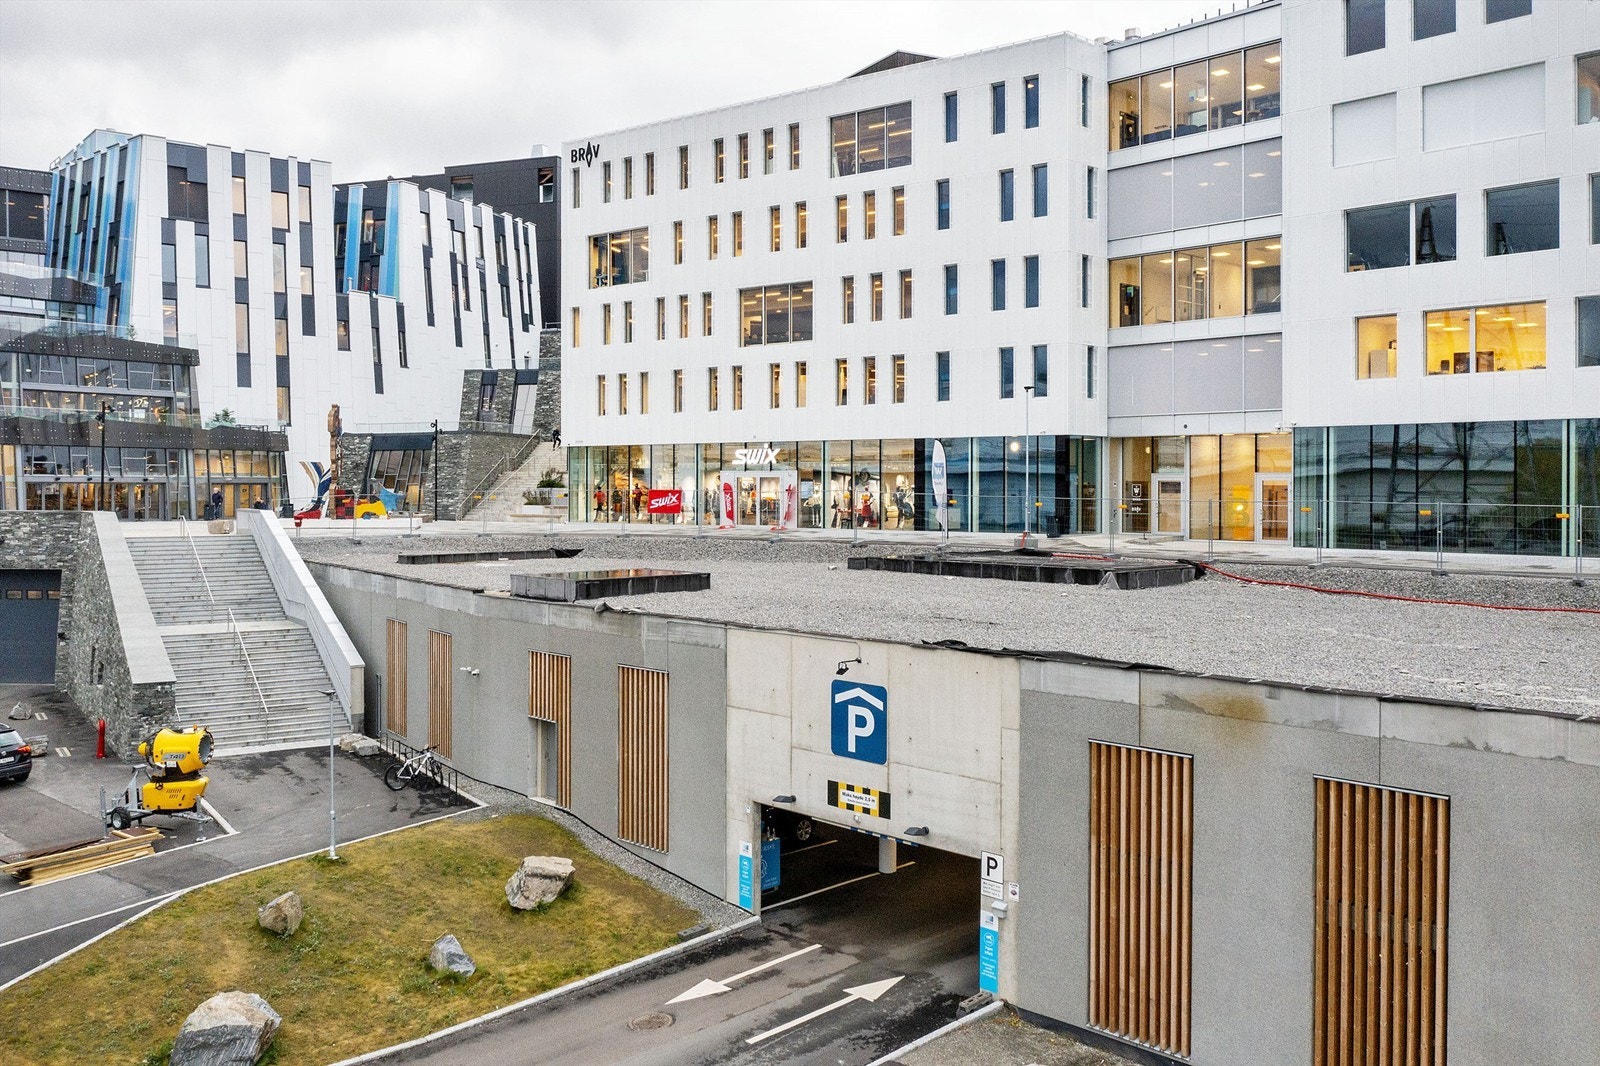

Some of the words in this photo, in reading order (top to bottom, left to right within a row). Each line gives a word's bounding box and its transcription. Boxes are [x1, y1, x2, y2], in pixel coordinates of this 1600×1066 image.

[570, 141, 600, 168] BRAV
[847, 704, 875, 753] P
[986, 856, 998, 877] P
